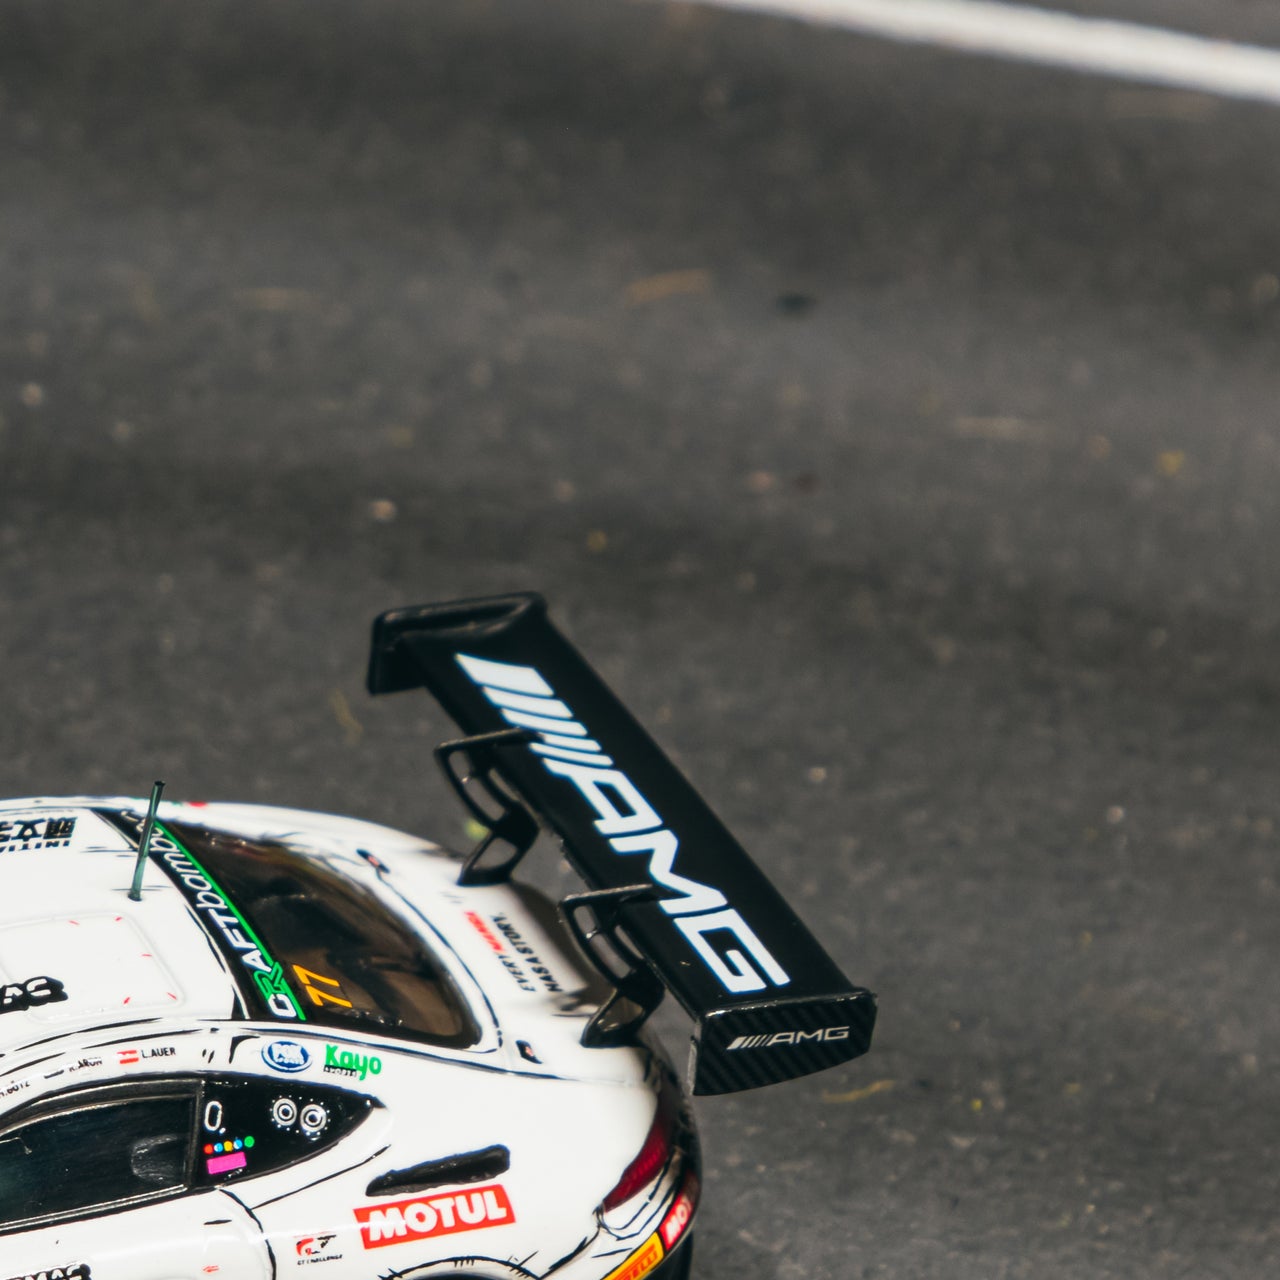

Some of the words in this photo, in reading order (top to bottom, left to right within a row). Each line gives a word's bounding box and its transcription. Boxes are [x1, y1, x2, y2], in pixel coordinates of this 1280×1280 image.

[542, 756, 791, 995] AMG
[293, 964, 353, 1008] 77
[766, 1026, 850, 1047] AMG
[326, 1044, 382, 1081] Kayo
[369, 1191, 508, 1242] MOTUL
